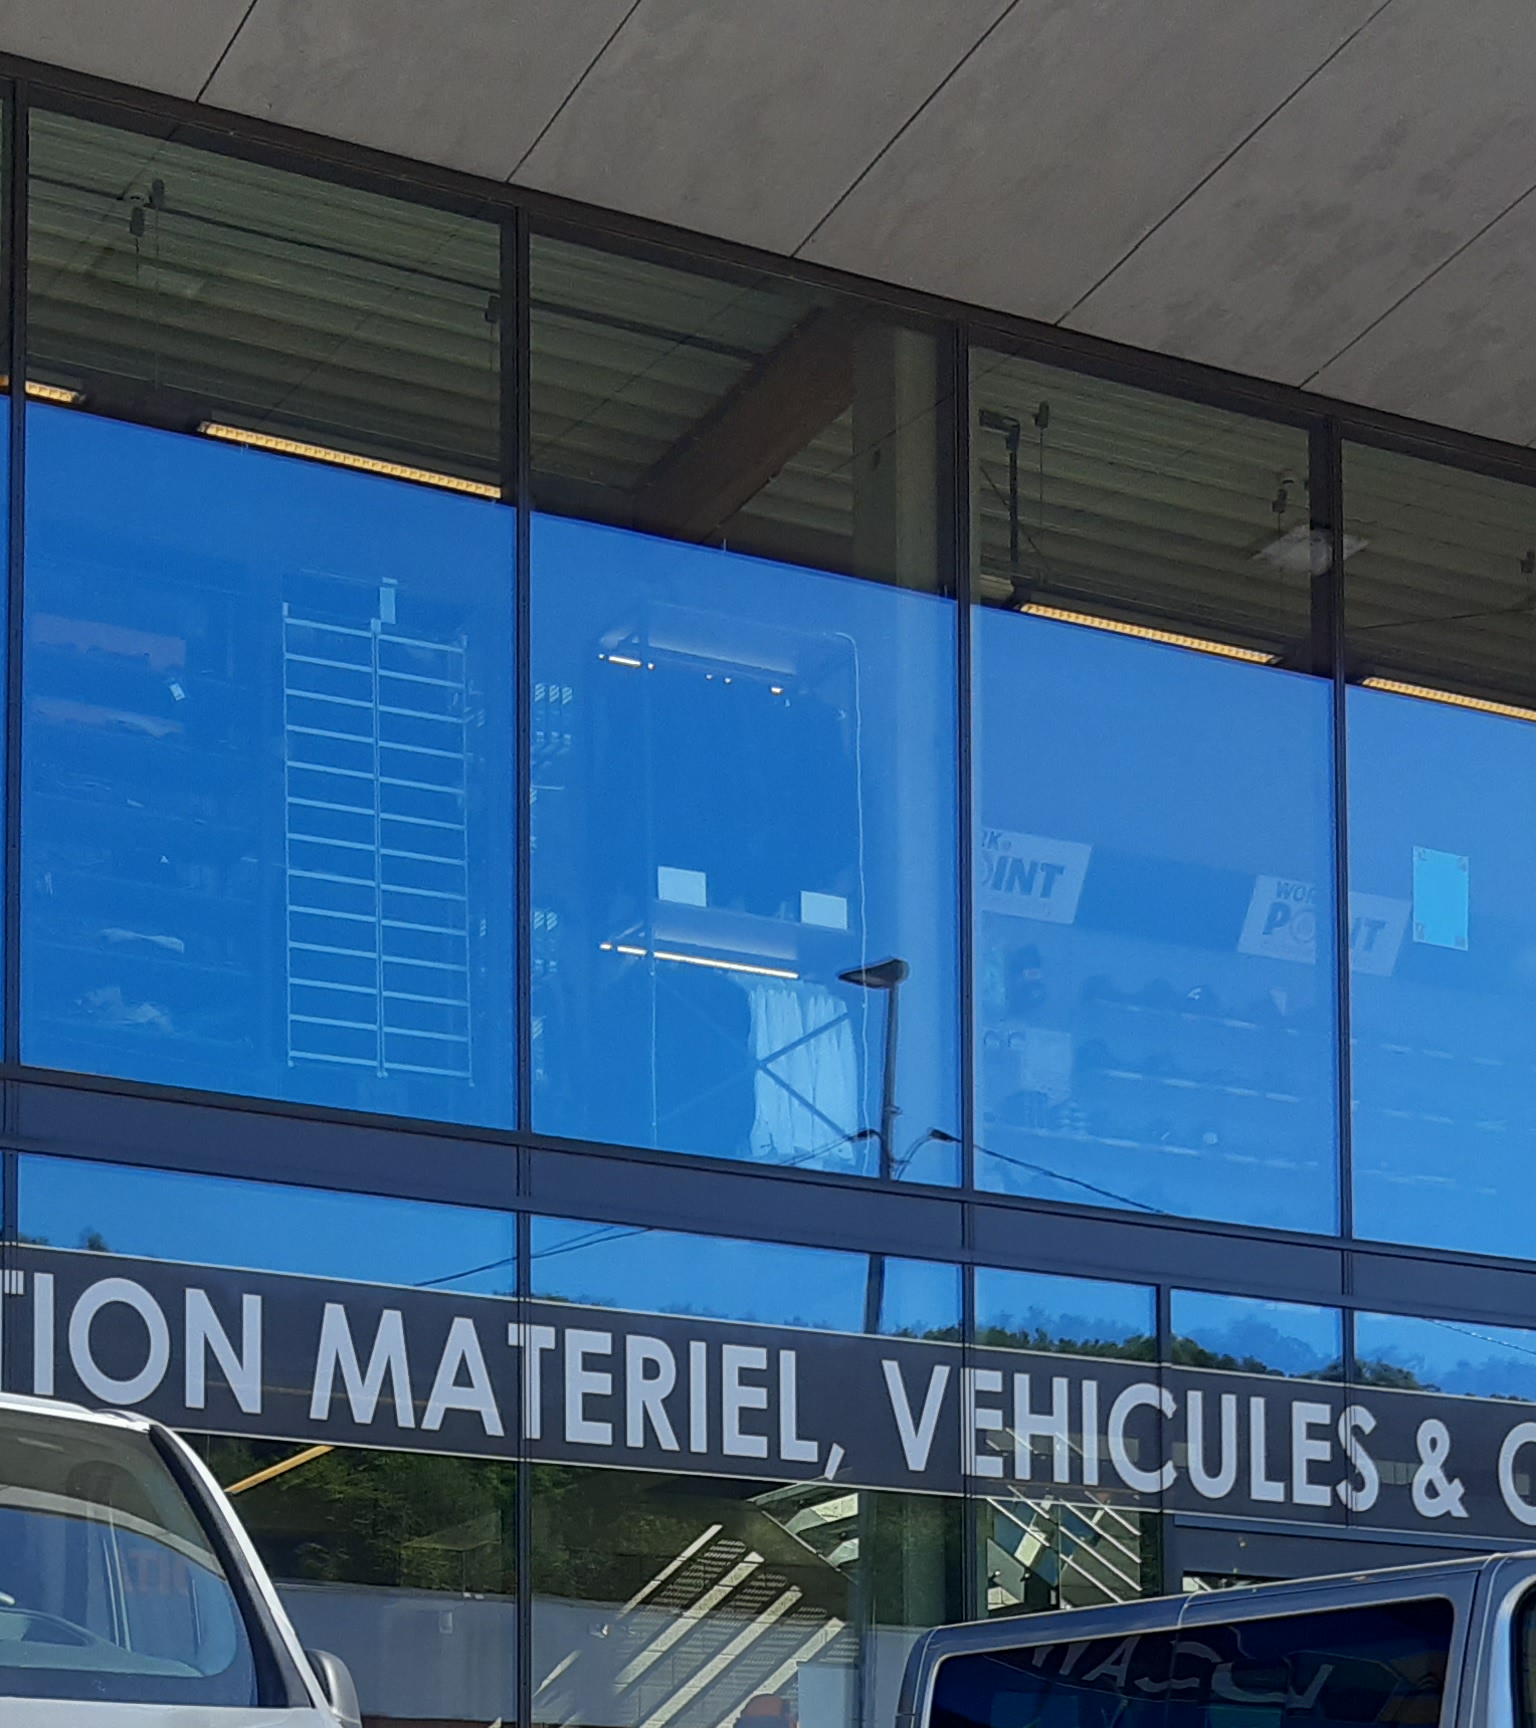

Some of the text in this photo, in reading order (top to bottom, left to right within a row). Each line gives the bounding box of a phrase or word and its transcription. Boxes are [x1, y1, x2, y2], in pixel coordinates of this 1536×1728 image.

[309, 1302, 845, 1480] MATERIEL,
[881, 1359, 1379, 1512] VEHICULES
[1412, 1418, 1469, 1519] &
